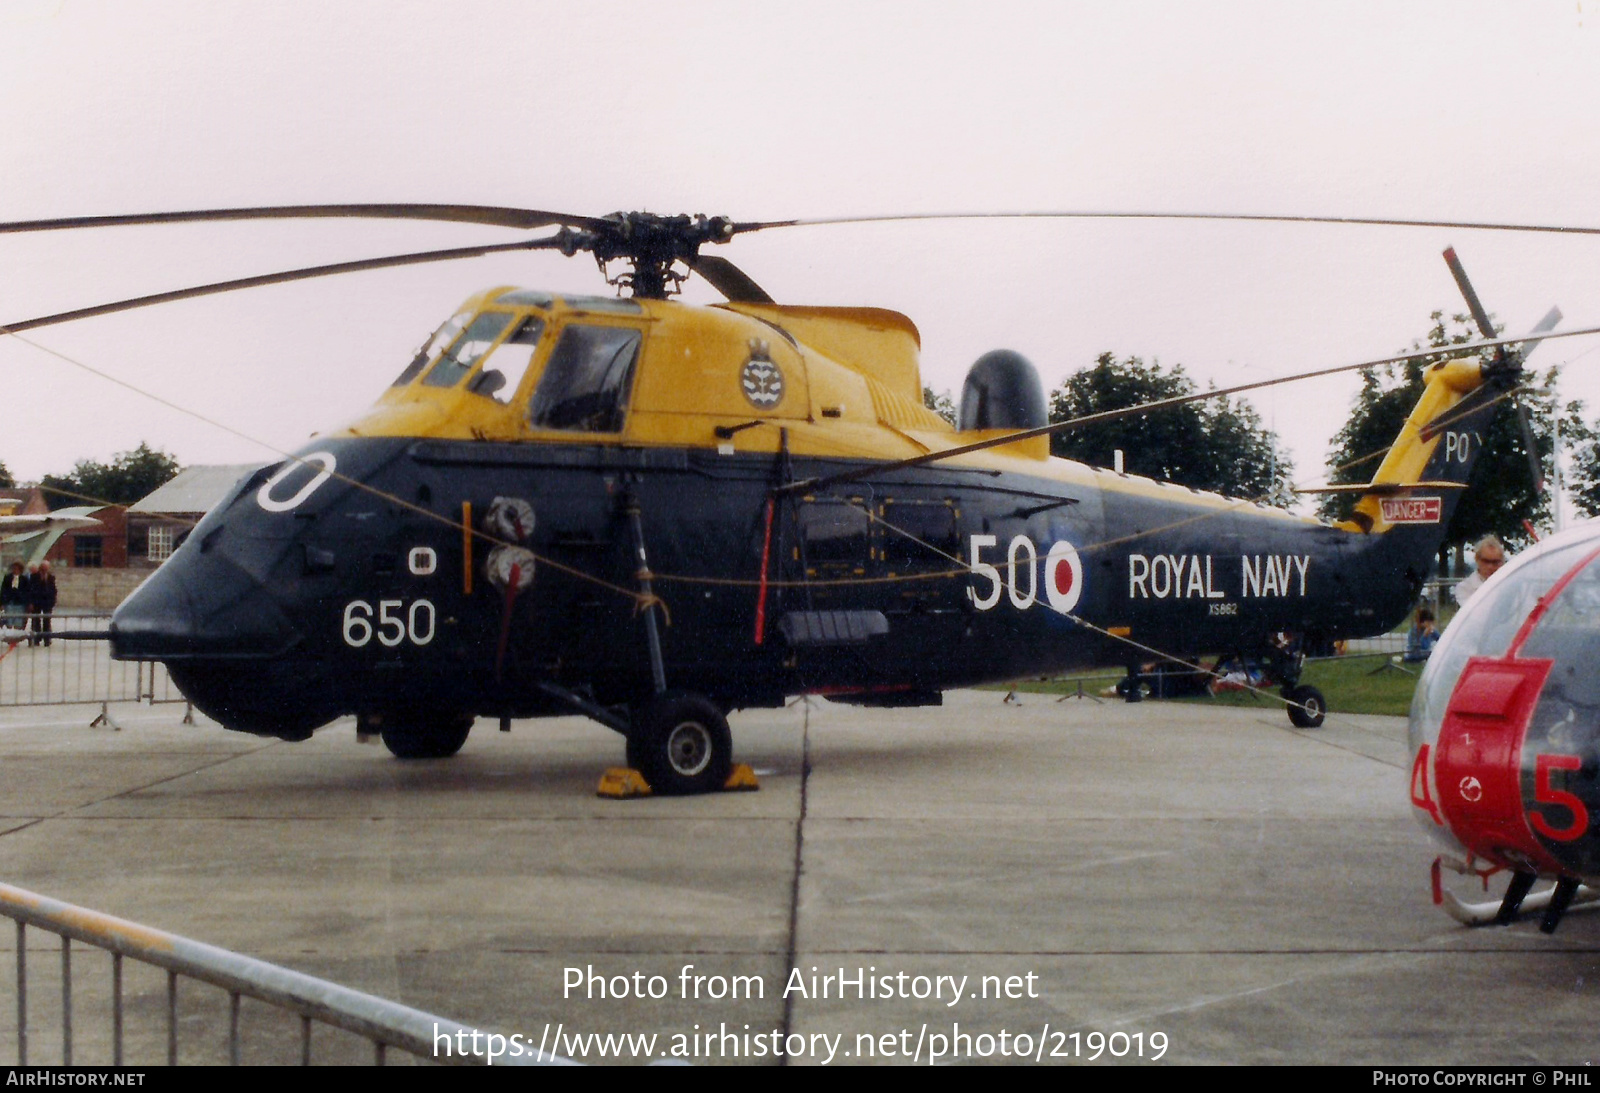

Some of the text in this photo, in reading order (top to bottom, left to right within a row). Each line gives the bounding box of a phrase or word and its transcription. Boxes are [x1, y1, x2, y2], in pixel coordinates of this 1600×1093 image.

[1445, 431, 1470, 463] PO
[1383, 501, 1427, 519] DANGER
[1128, 553, 1311, 599] ROYAL NAVY
[342, 598, 437, 648] 650
